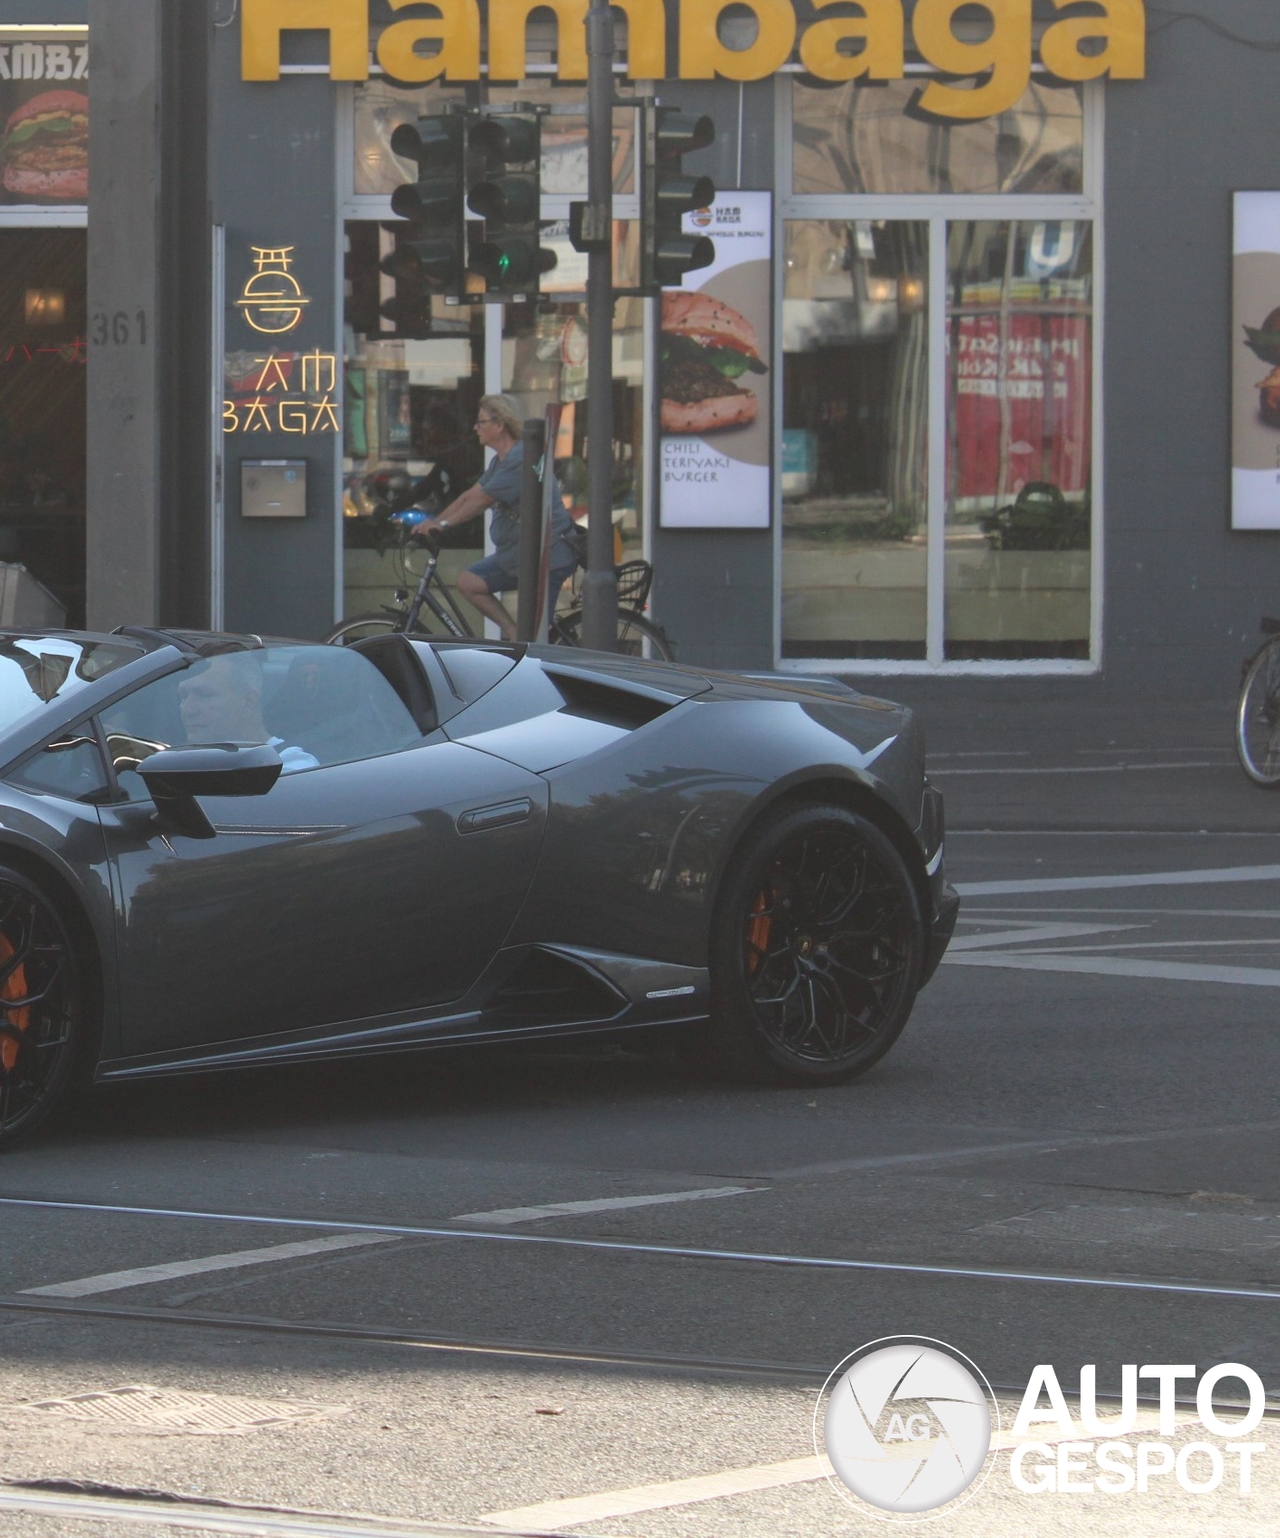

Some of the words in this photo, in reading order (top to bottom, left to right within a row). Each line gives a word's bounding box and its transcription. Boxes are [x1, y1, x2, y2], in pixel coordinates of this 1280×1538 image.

[241, 0, 1146, 119] Hambaga
[92, 309, 147, 346] 361
[222, 395, 340, 435] BAGA
[664, 443, 700, 454] CHILI
[664, 457, 730, 469] TERIYAKI
[664, 471, 718, 482] BURGER
